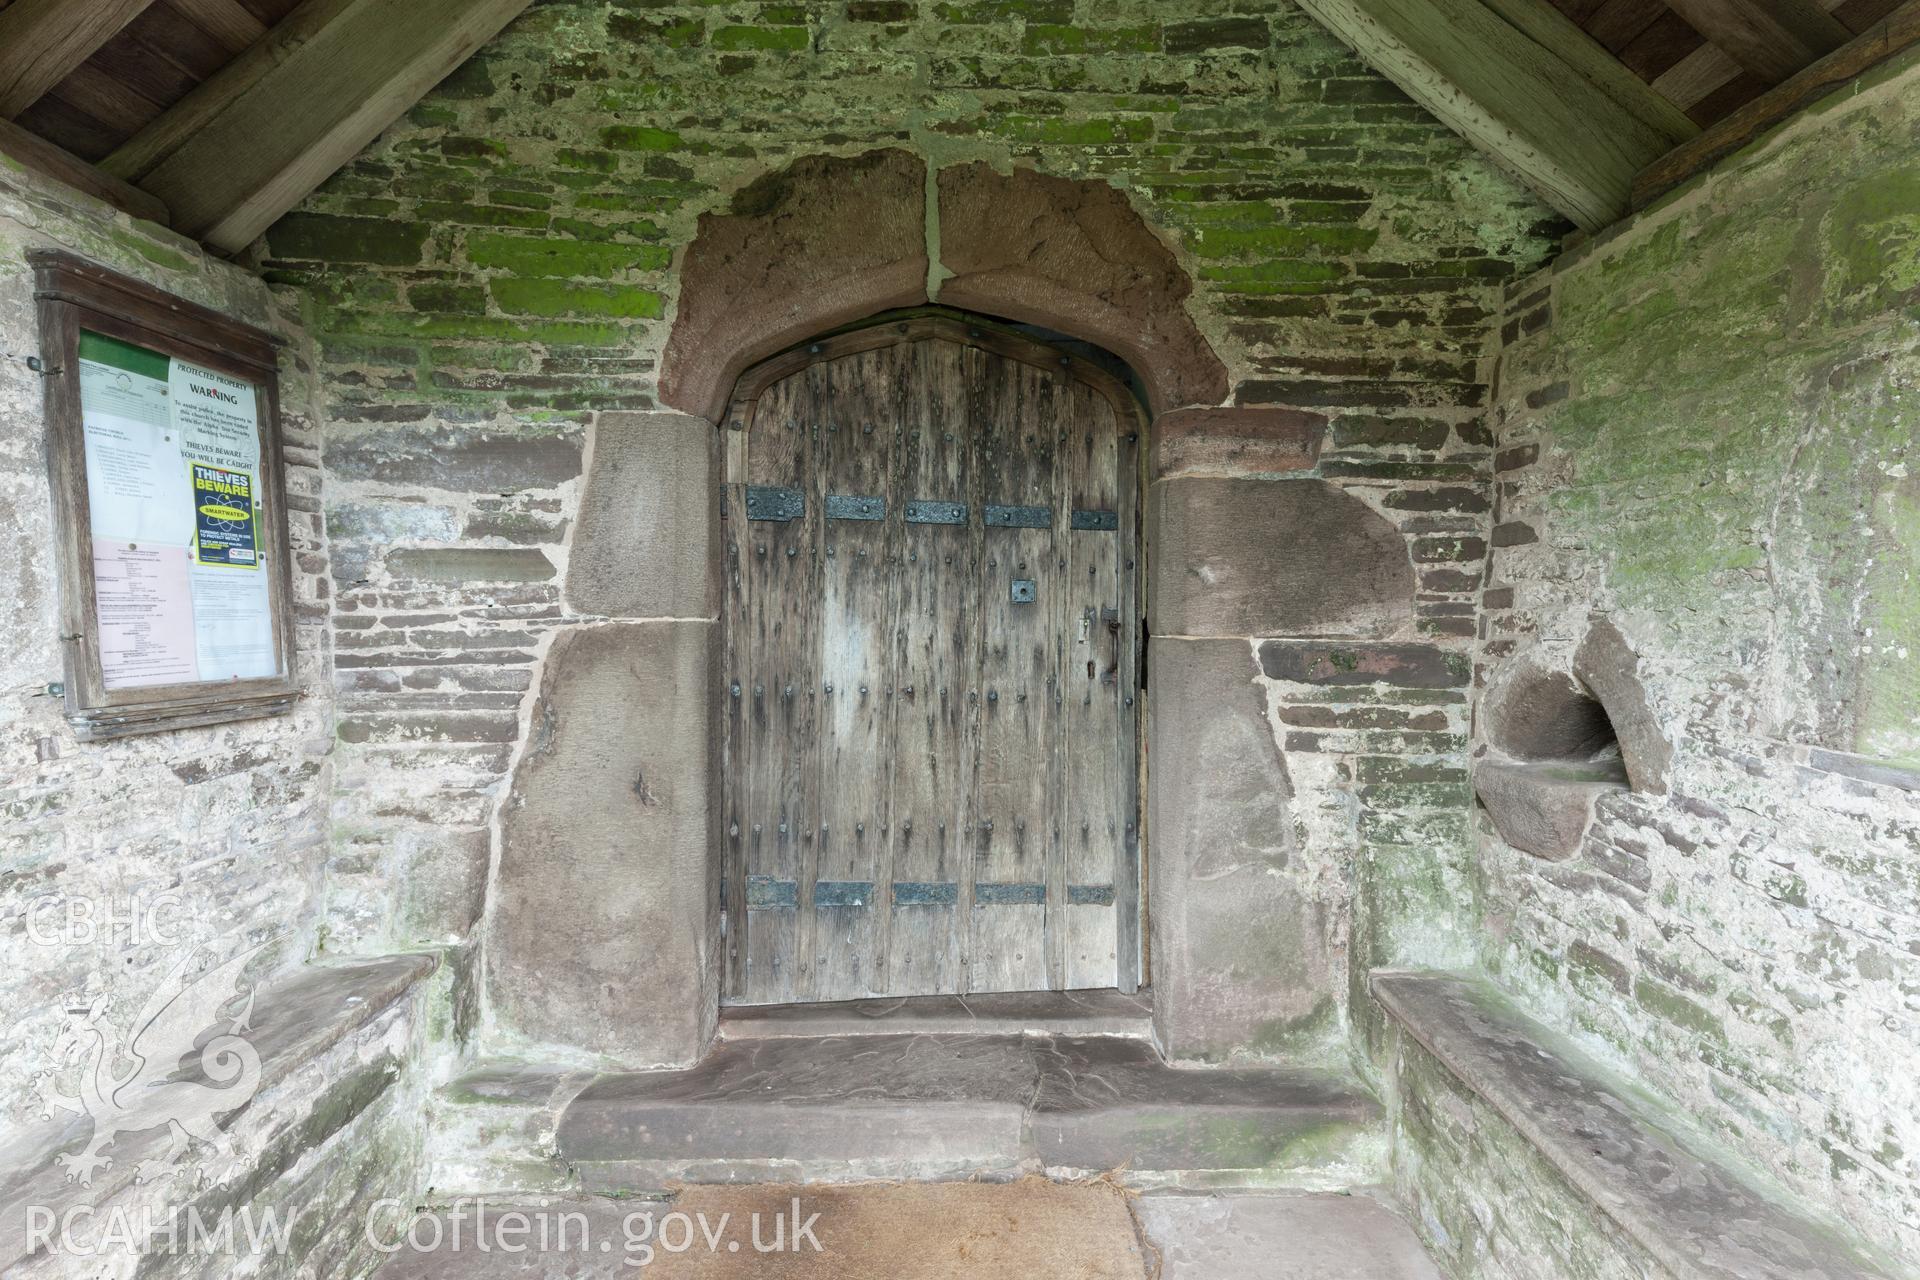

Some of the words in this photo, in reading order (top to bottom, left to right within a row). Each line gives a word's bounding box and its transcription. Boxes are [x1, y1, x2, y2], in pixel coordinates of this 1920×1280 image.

[177, 364, 214, 380] PROTECTED
[217, 376, 247, 391] PROPERTY
[189, 383, 238, 405] WARNING
[191, 412, 210, 421] church
[186, 440, 213, 453] THIEVES
[215, 447, 241, 458] BEWARE
[180, 450, 196, 460] YOU
[197, 453, 214, 463] WILL
[226, 459, 252, 470] CAUGHT
[195, 466, 249, 487] THIEVES
[196, 478, 249, 497] BEWARE
[205, 507, 245, 518] SMARTWATER
